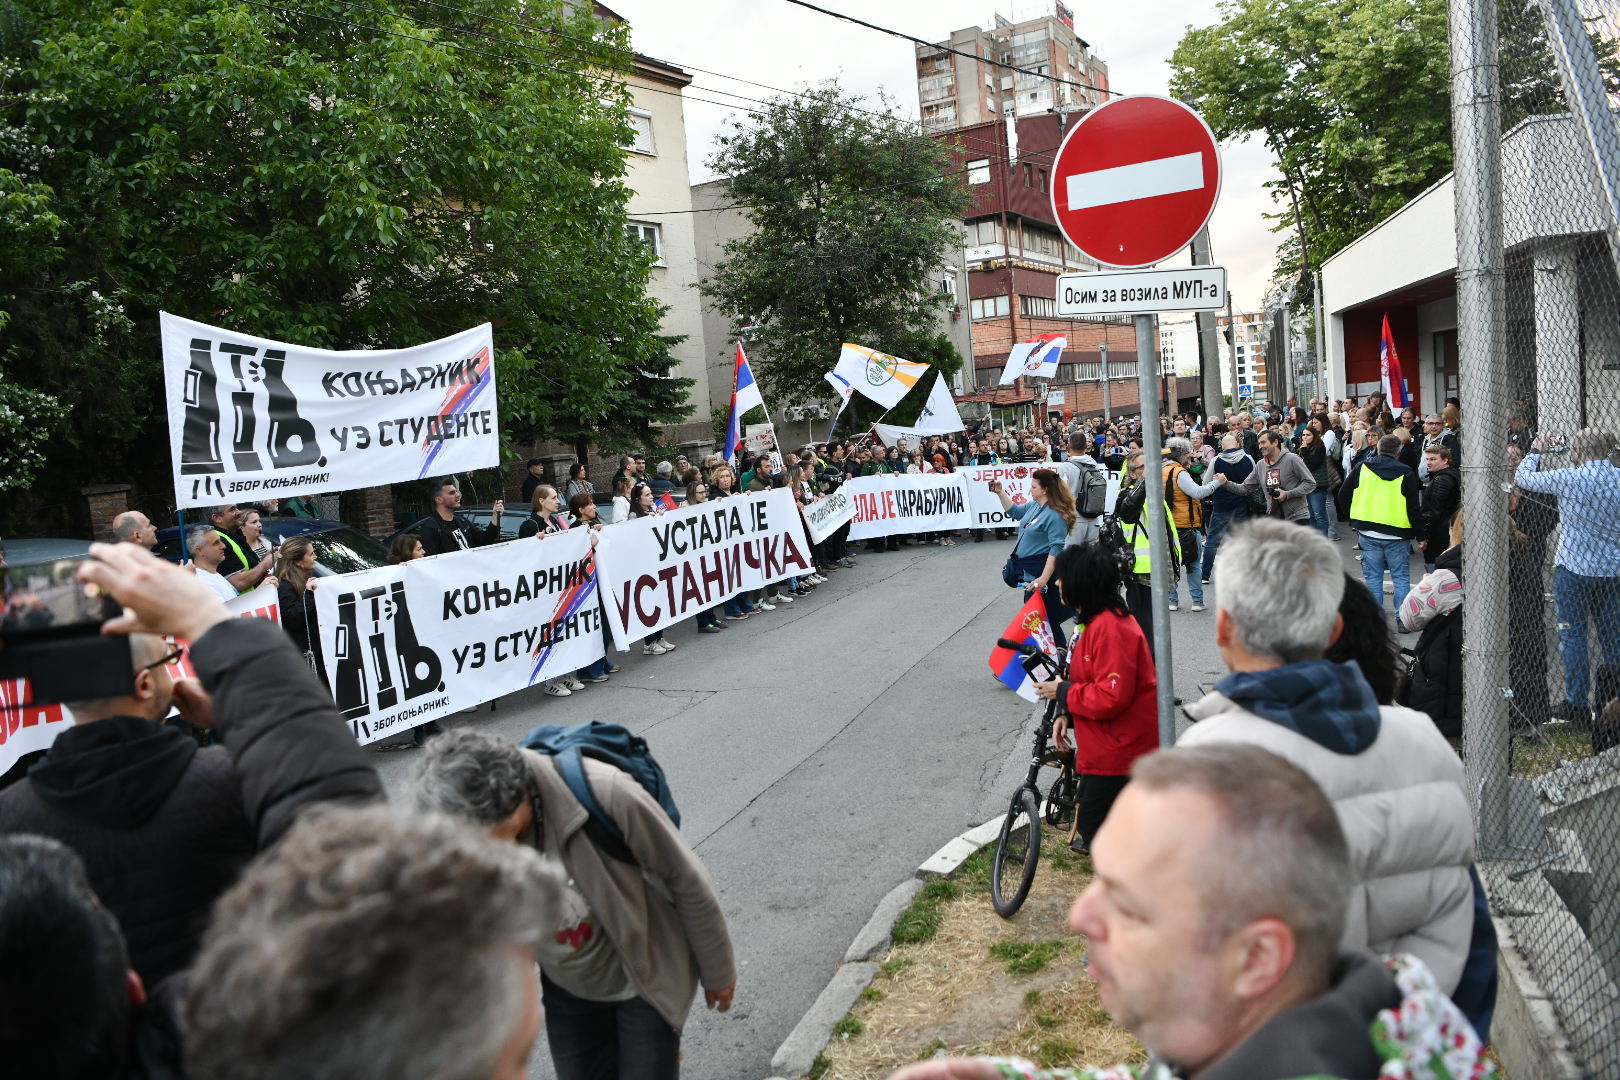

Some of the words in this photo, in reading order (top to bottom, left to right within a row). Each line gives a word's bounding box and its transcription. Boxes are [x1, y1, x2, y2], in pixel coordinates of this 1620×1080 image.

[1065, 287, 1097, 304] Осим
[1102, 289, 1116, 302] за
[1121, 287, 1168, 301] возила
[1173, 280, 1217, 299] МУП-а
[321, 357, 481, 398] КОЊАРНИК
[378, 410, 492, 447] СТУДЕНТЕ
[228, 480, 260, 493] ЗБОР
[262, 473, 330, 490] КОЊАРНИК!
[895, 486, 965, 517] КАРАБУРМА
[652, 506, 744, 561] УСТАЛА
[751, 501, 768, 533] ЈЕ
[442, 557, 593, 620] КОЊАРНИК
[452, 641, 486, 674] УЗ
[494, 606, 600, 662] СТУДЕНТЕ
[373, 717, 396, 732] ЗБОР
[397, 696, 450, 726] КОЊАРНИК!
